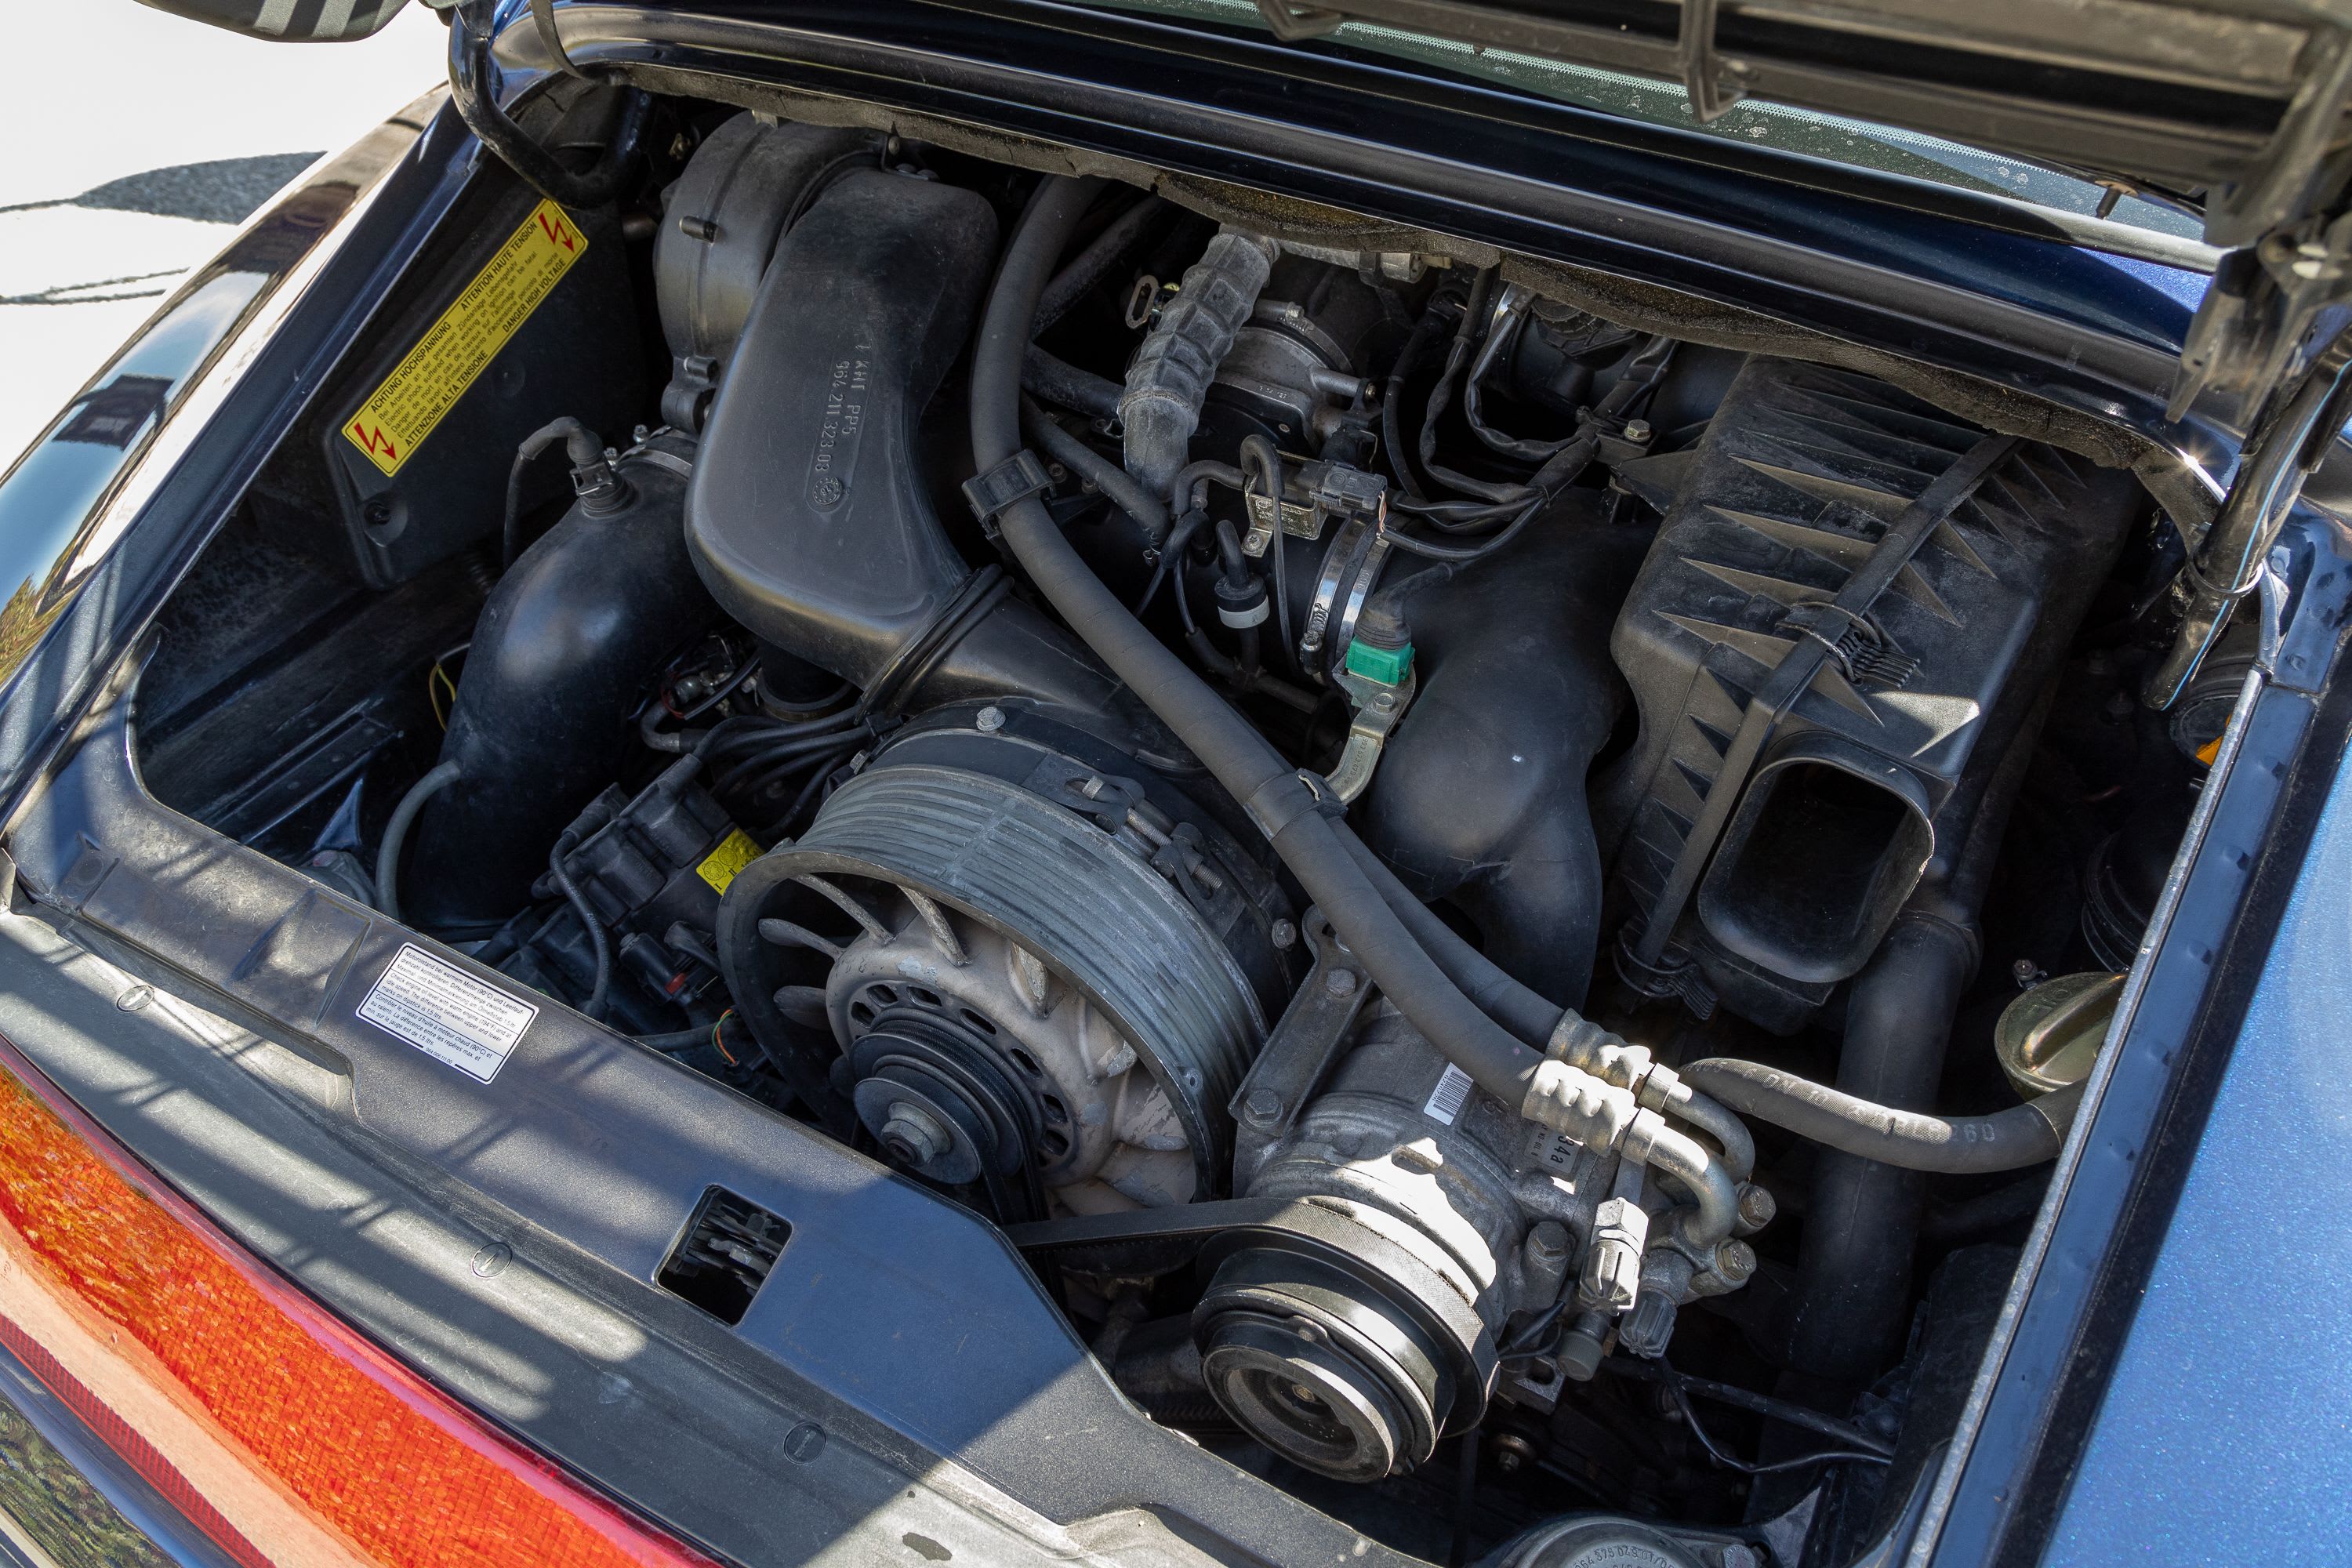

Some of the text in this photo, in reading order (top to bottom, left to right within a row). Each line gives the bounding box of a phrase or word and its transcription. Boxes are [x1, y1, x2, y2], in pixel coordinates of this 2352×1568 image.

[459, 221, 538, 310] ATTENTION HAUTE TENSION
[502, 258, 565, 332] DANGER HIGH VOLTAGE
[369, 321, 451, 412] ACHTUNG HOCHSPANNUNG
[377, 407, 390, 420] Bei
[389, 382, 412, 408] Arbeiten
[412, 372, 422, 383] an
[420, 359, 432, 372] der
[432, 331, 458, 361] gesamten
[385, 403, 405, 426] Electric
[405, 383, 423, 403] shock
[423, 358, 445, 383] suffered
[443, 340, 459, 359] when
[459, 318, 480, 342] working
[479, 308, 488, 318] on
[488, 286, 507, 309] ignition
[506, 274, 517, 288] can
[516, 264, 525, 274] be
[391, 410, 412, 433] Danger
[410, 398, 421, 410] de
[419, 383, 434, 400] mort
[434, 374, 443, 384] en
[441, 361, 454, 375] cas
[452, 351, 462, 362] de
[462, 329, 481, 351] travaux
[481, 318, 491, 329] sur
[397, 405, 427, 438] Effettuando
[426, 386, 443, 405] lavori
[464, 336, 487, 361] impianto
[517, 276, 538, 300] pericolo
[535, 267, 544, 277] di
[543, 251, 559, 270] morte
[404, 350, 488, 447] ATTENZIONE ALTA TENSIONE
[380, 984, 397, 996] marks
[401, 995, 422, 1010] dipstick
[388, 1018, 403, 1030] jauge
[401, 1007, 419, 1019] niveau
[437, 1026, 456, 1039] moteur
[454, 1035, 471, 1047] chaud
[419, 996, 445, 1011] difference
[442, 1008, 465, 1022] between
[463, 1019, 478, 1031] upper
[477, 1026, 488, 1036] and
[487, 1031, 503, 1043] lower
[442, 971, 463, 984] warmem
[462, 980, 478, 991] Motor
[492, 996, 503, 1004] und
[423, 1028, 437, 1038] entre
